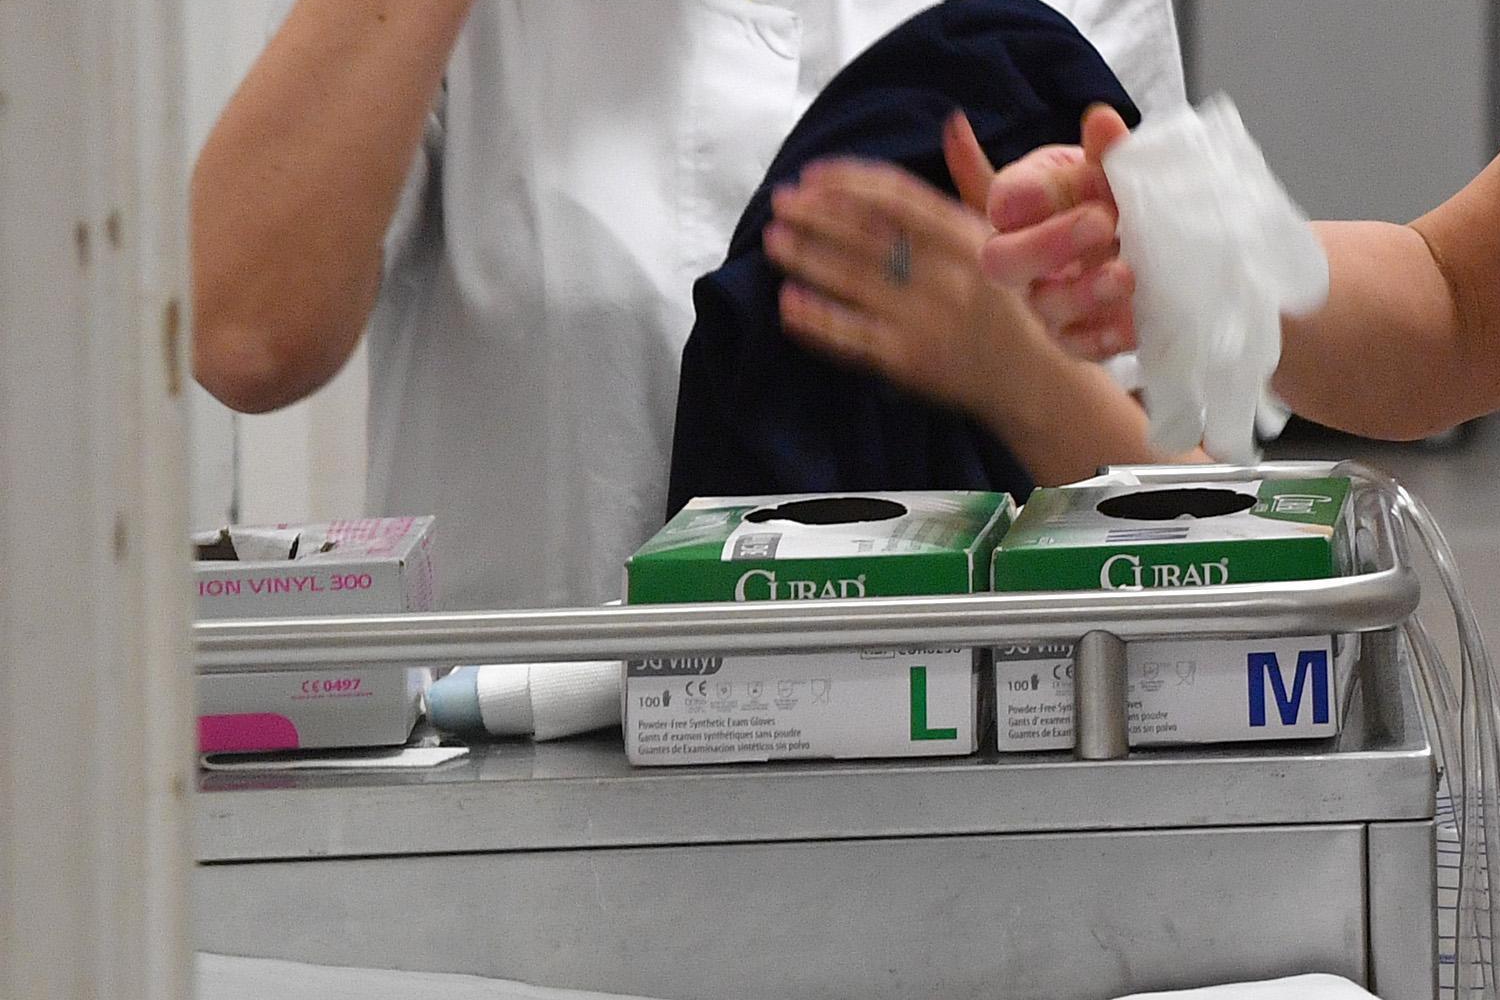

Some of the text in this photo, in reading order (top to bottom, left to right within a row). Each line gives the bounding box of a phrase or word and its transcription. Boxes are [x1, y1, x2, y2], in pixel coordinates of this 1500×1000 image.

[199, 574, 372, 597] ION VINYL 300
[323, 679, 361, 692] 0497
[1008, 680, 1029, 691] 100
[1247, 650, 1329, 728] M
[639, 696, 660, 708] 100
[910, 666, 957, 740] L
